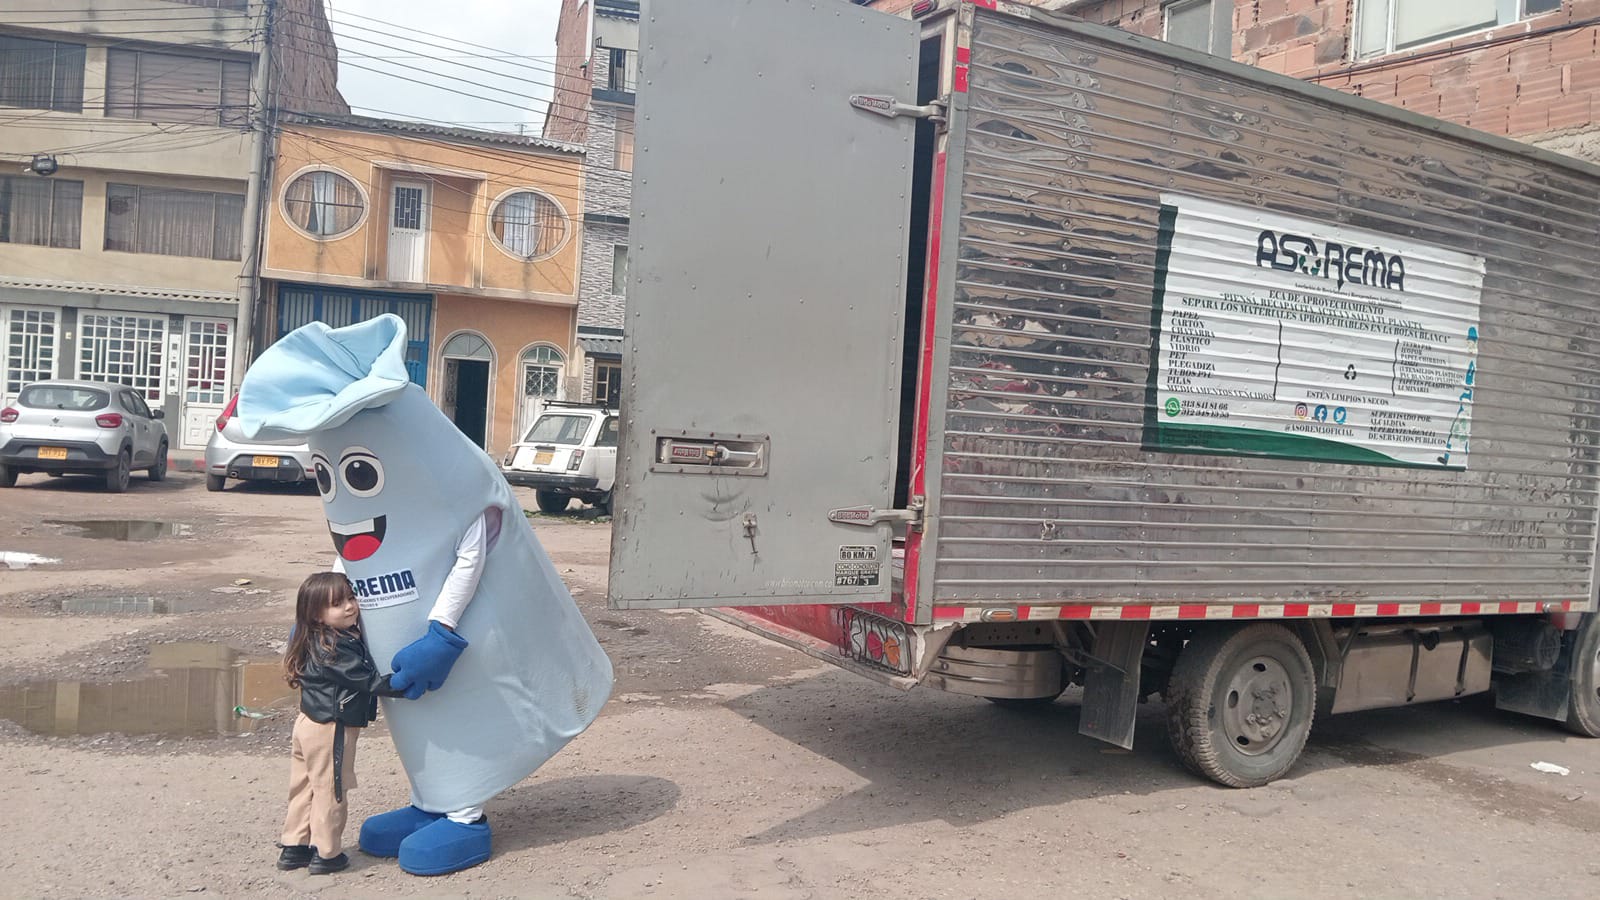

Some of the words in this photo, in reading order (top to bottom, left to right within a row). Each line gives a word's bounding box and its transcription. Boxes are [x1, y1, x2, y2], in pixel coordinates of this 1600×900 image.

[1256, 230, 1405, 291] ASOREMA
[1269, 289, 1286, 300] ECA
[1288, 293, 1300, 303] DE
[1303, 295, 1384, 315] APROVECHAMIENTO
[1172, 309, 1200, 320] PAPEL
[1182, 296, 1218, 310] SEPARA
[1220, 302, 1238, 313] LOS
[1240, 304, 1297, 321] MATERIALES
[1299, 313, 1369, 331] APROVECHABLES
[1370, 323, 1381, 333] EN
[1383, 325, 1392, 335] LA
[1394, 327, 1418, 339] BOLSA
[1171, 326, 1216, 339] CHATARRA
[1169, 342, 1200, 353] VIDRIO
[1169, 350, 1187, 360] PET
[1168, 359, 1216, 371] PLEGADIZA
[1167, 376, 1191, 385] PILAS
[1166, 384, 1233, 397] MEDICAMENTOS
[1331, 392, 1361, 402] LIMPIOS
[1367, 396, 1389, 406] SECOS
[1370, 410, 1416, 421] SUPERVISADO
[1368, 432, 1378, 440] DE
[1379, 434, 1414, 442] SERVICIOS
[853, 551, 873, 559] KM/H
[837, 576, 858, 585] #767
